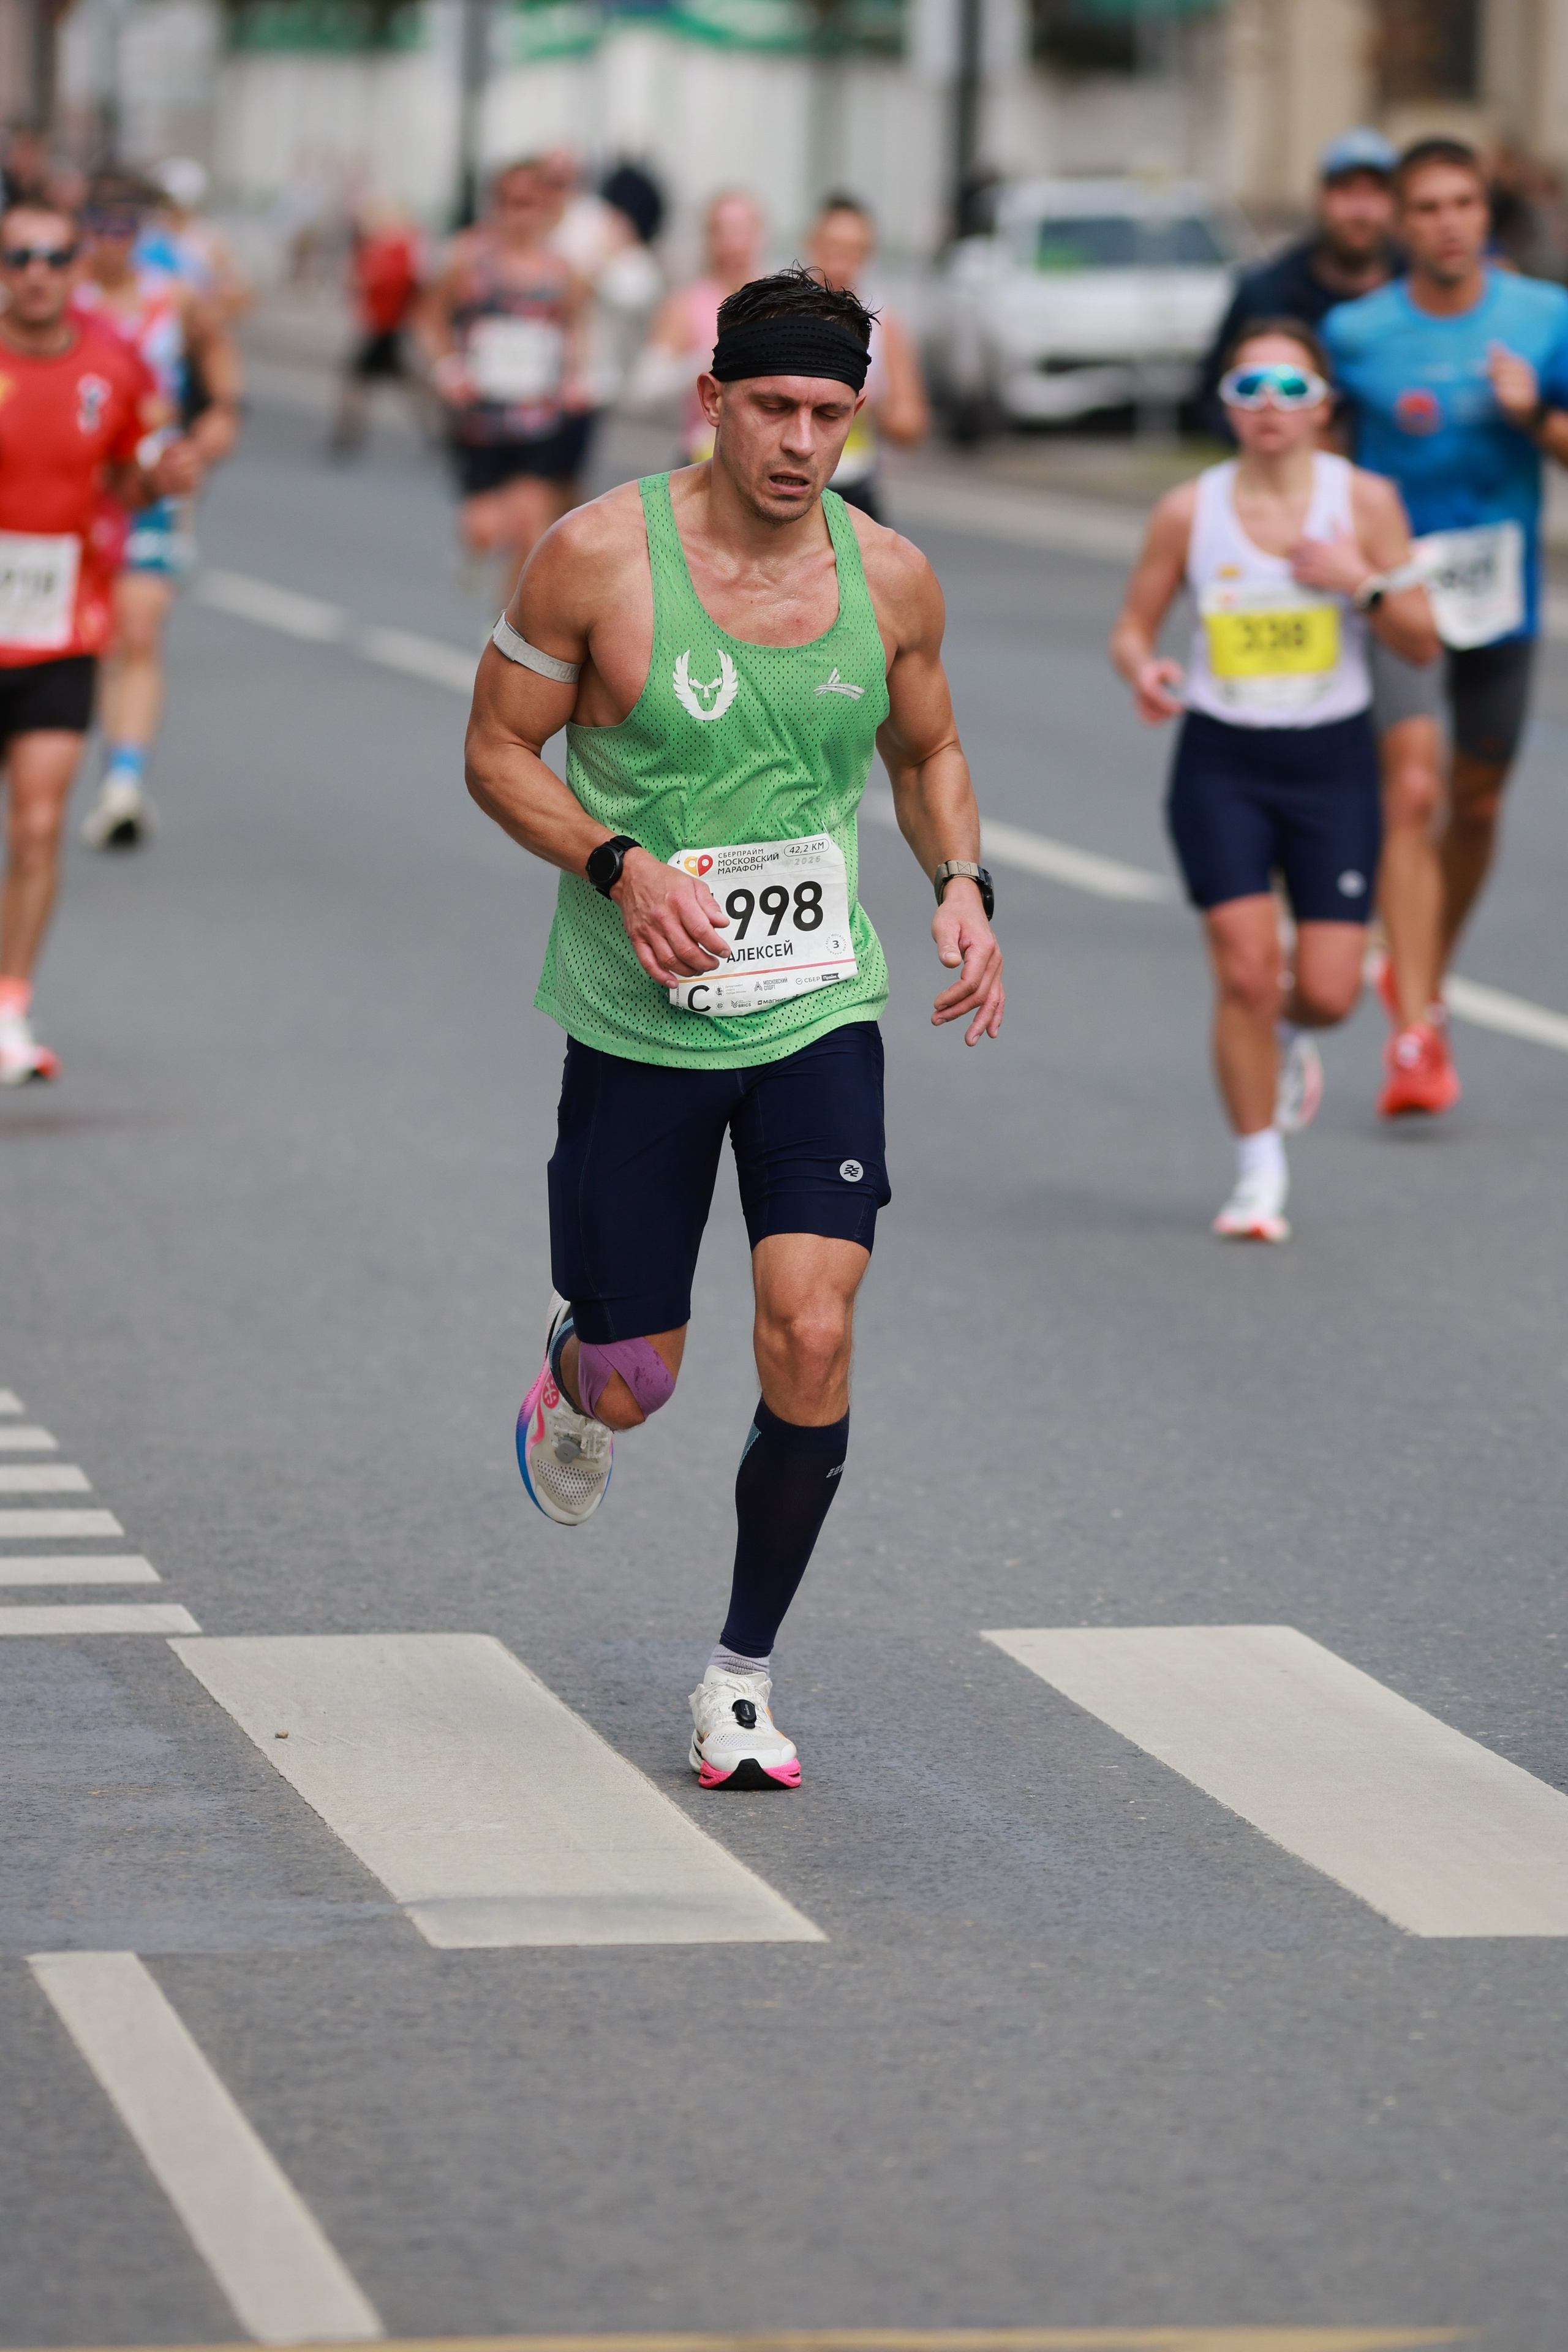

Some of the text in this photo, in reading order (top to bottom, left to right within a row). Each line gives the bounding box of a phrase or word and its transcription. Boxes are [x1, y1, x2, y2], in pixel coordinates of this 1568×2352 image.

[718, 848, 764, 859] СБЕРПРАЙМ
[789, 845, 809, 854] 42,2
[718, 852, 779, 867] МОСКОВСКИЙ
[794, 856, 821, 865] 2026
[718, 863, 763, 875] МАРАФОН
[711, 881, 823, 941] 998
[832, 940, 839, 949] 3
[726, 940, 793, 963] АЛЕКСЕЙ
[763, 976, 788, 985] МОСКОВСКИЙ
